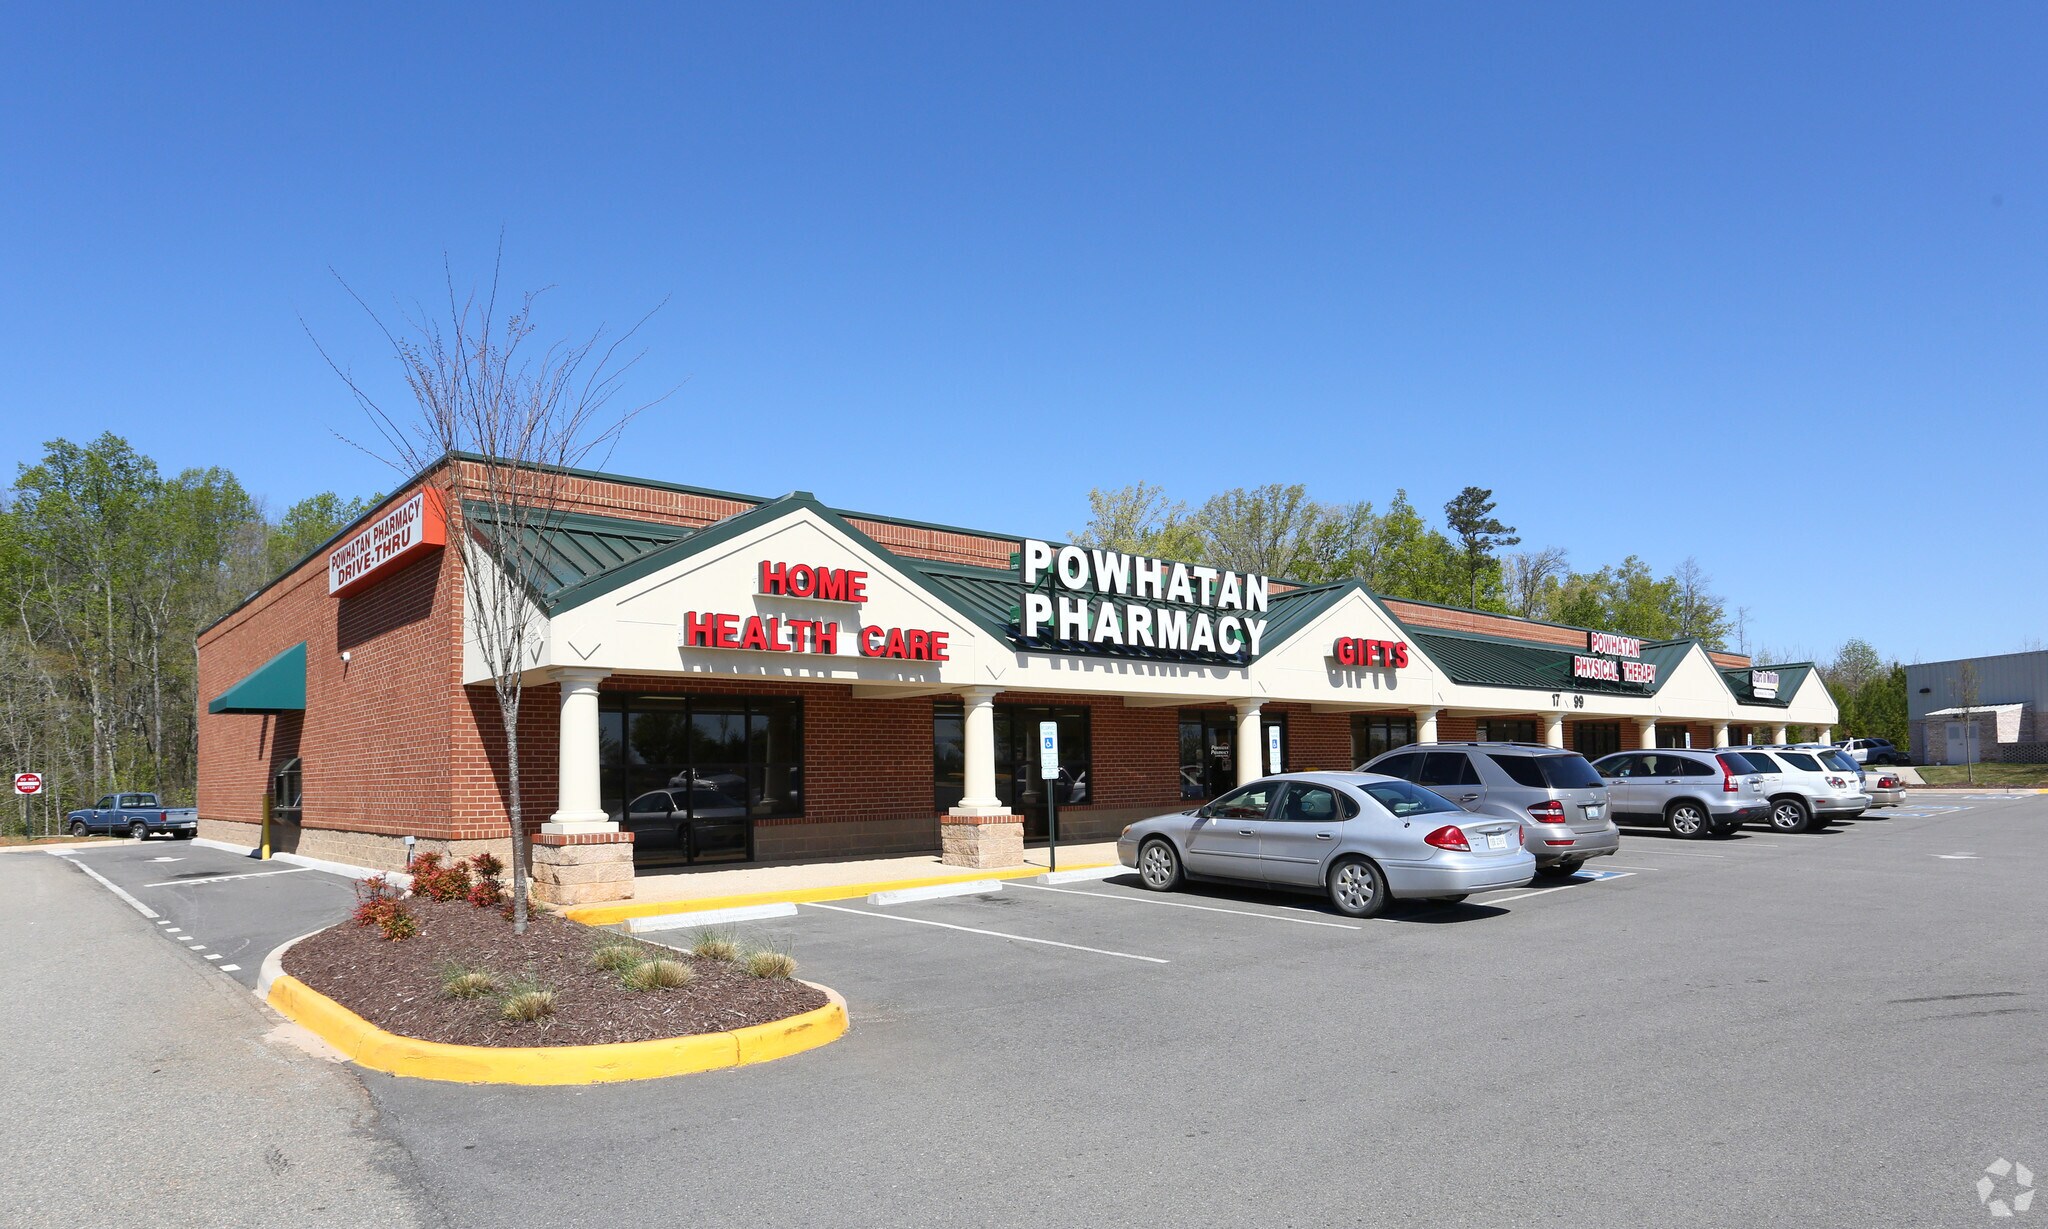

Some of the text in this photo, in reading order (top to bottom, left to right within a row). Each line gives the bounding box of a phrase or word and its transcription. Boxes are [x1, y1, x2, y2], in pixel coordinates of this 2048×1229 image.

[331, 497, 421, 572] POWHATAN PHARMACY
[338, 525, 411, 586] DRIVE-THRU
[760, 560, 868, 602] HOME
[1022, 538, 1268, 612] POWHATAN
[685, 611, 949, 661] HEALTH CARE
[1022, 592, 1268, 656] PHARMACY
[1591, 632, 1640, 658] POWHATAN
[1335, 636, 1409, 669] GIFTS
[1574, 656, 1656, 683] PHYSICAL THERAPY
[1552, 694, 1584, 709] 17 99
